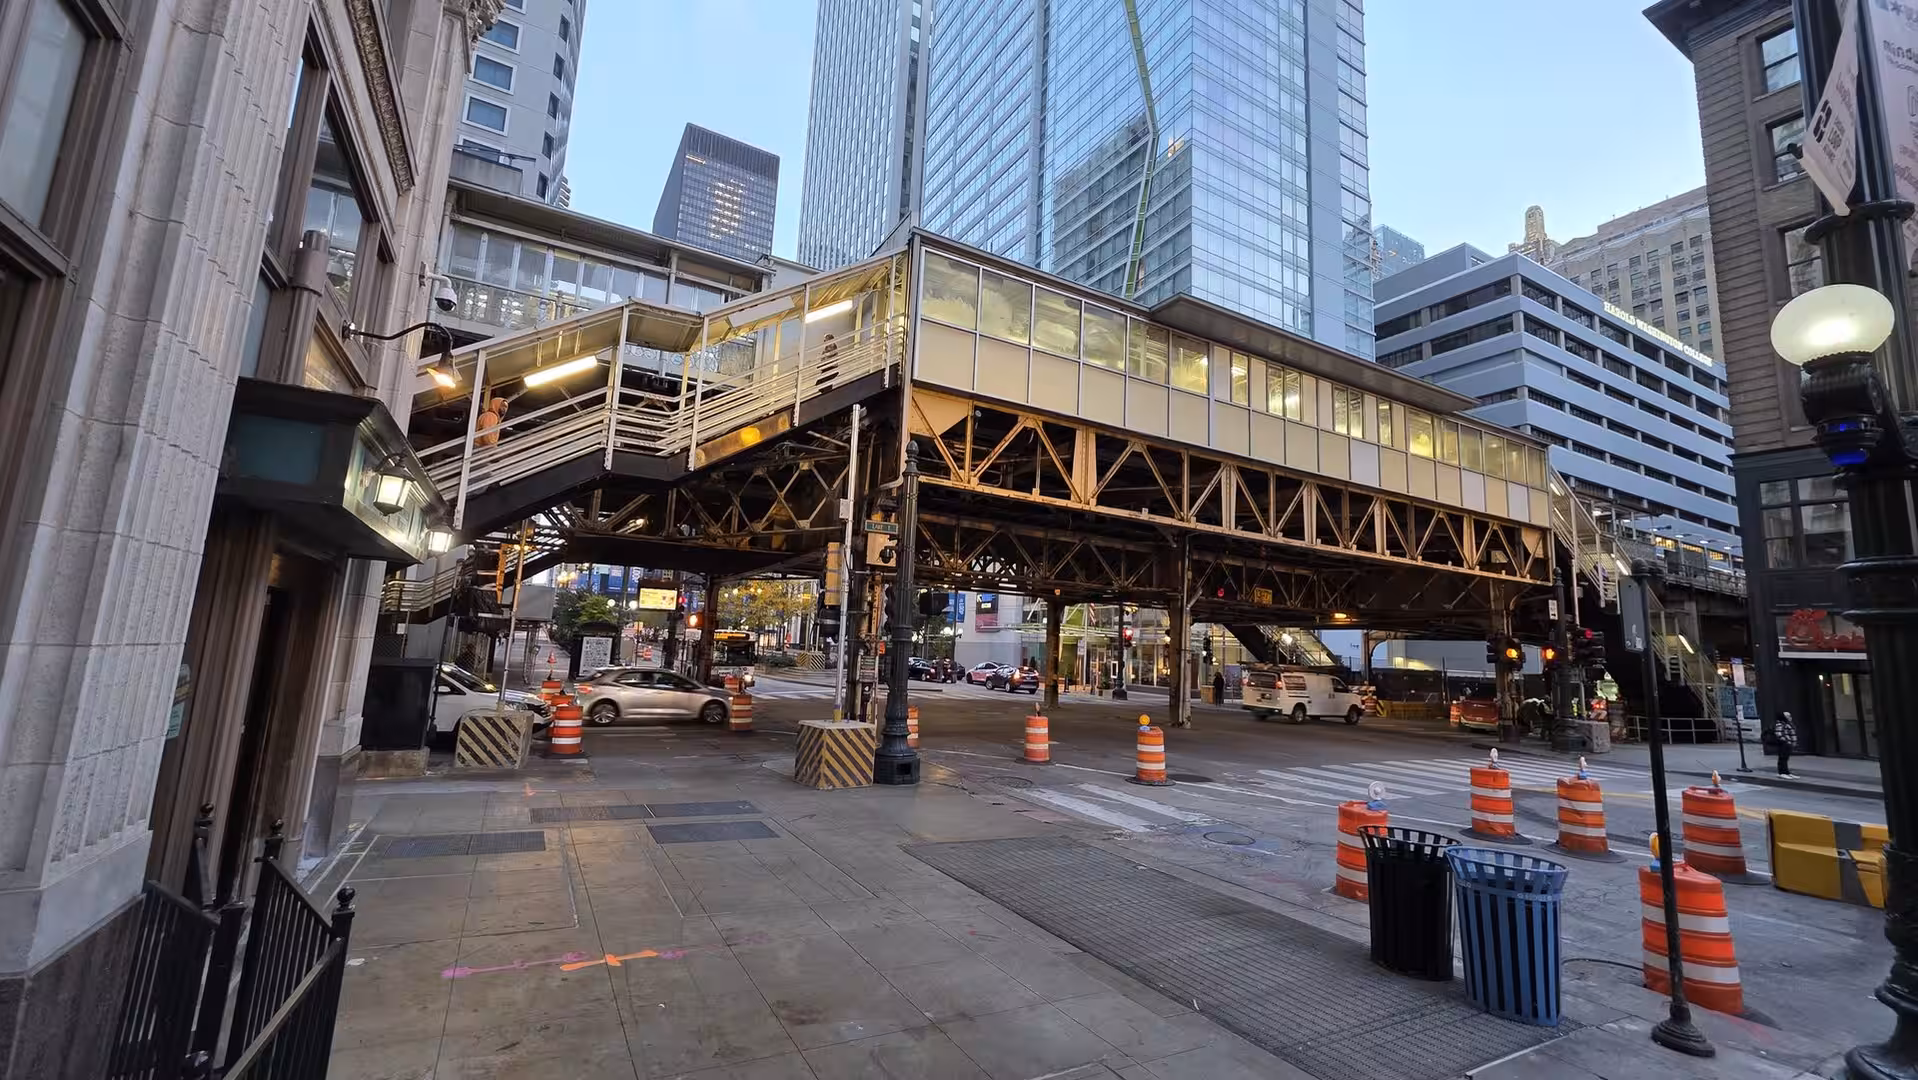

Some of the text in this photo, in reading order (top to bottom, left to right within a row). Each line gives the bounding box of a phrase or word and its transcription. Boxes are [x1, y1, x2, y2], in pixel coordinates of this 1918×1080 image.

[1603, 301, 1713, 368] HAROLD WASHINGTON COLLEGE
